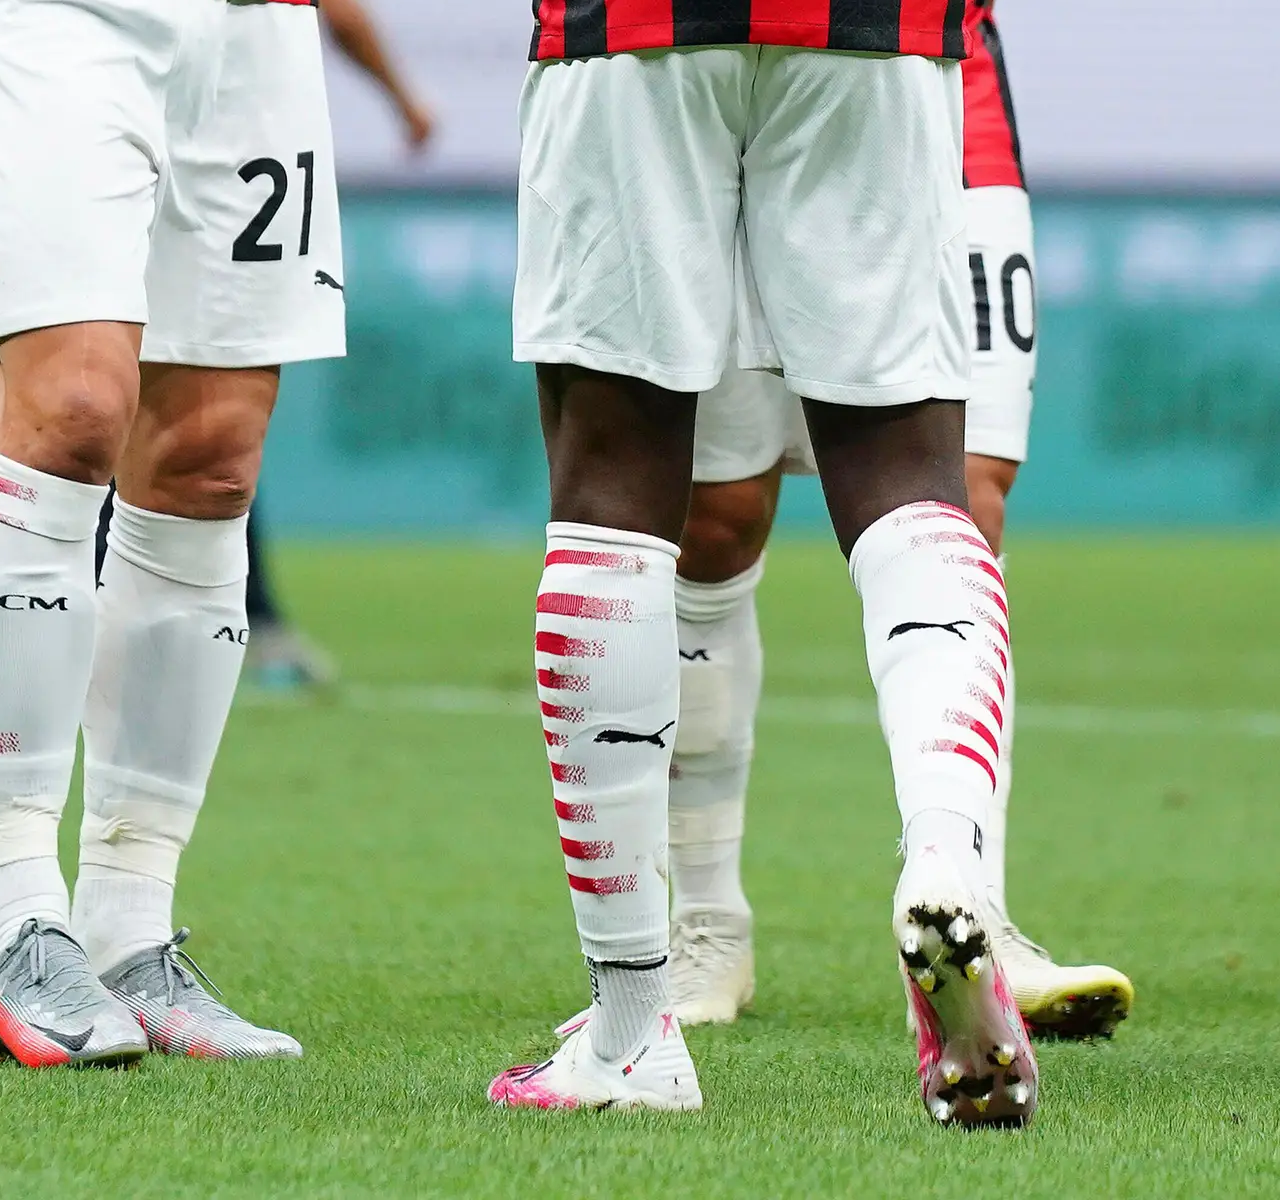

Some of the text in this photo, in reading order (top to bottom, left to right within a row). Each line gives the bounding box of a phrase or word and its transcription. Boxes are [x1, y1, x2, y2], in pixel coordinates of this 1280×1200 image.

[232, 150, 314, 262] 21
[968, 253, 1036, 353] 10
[212, 626, 249, 646] AC
